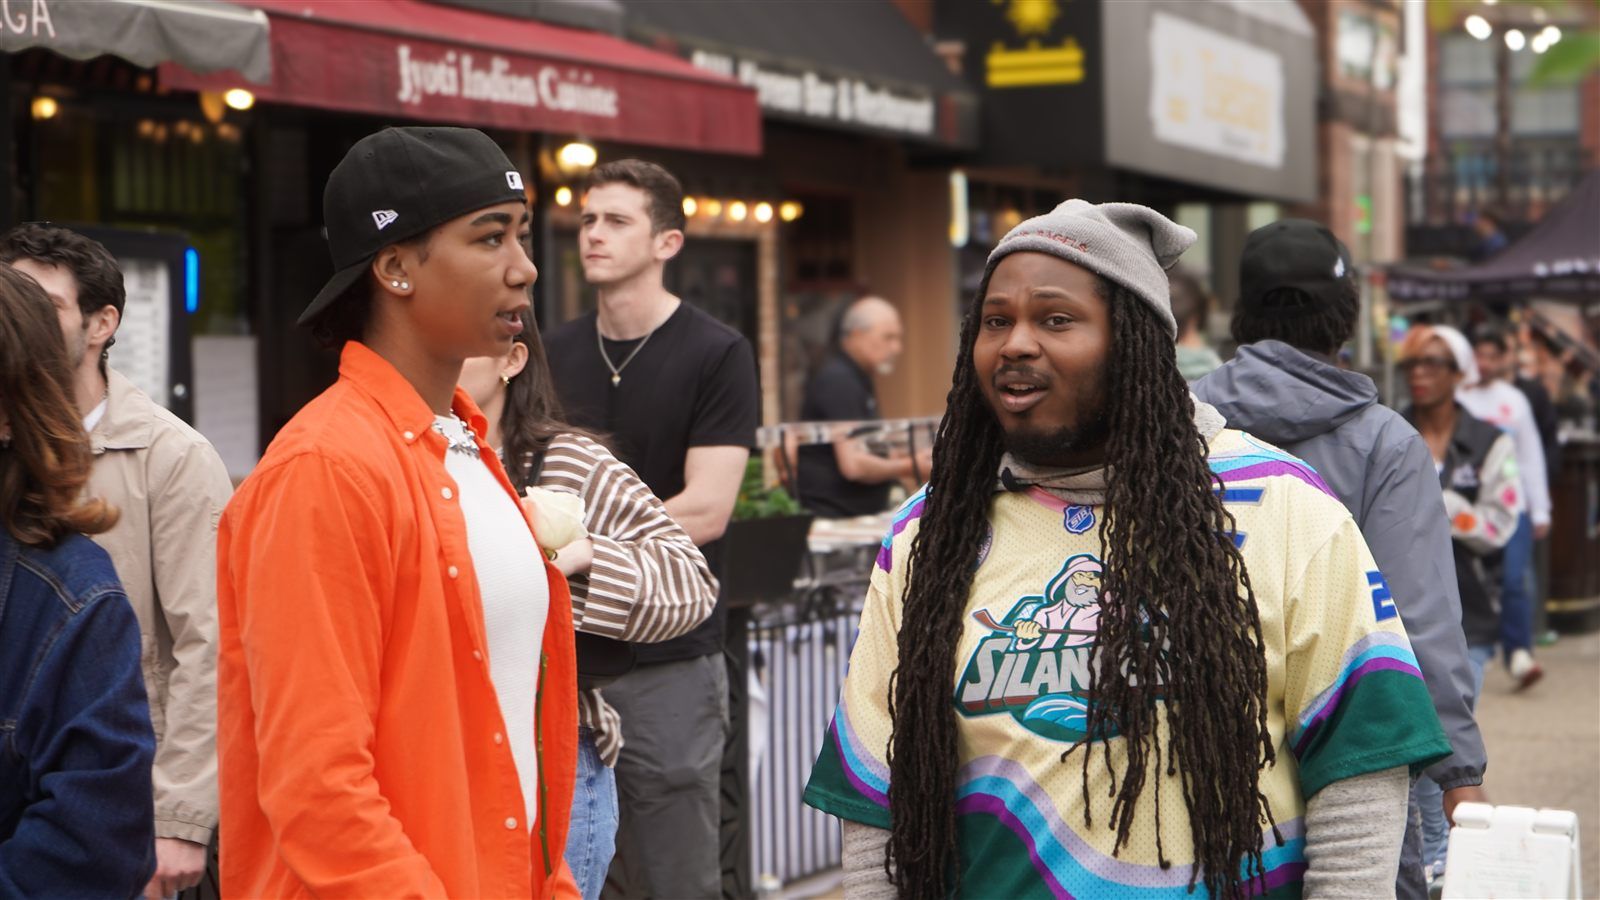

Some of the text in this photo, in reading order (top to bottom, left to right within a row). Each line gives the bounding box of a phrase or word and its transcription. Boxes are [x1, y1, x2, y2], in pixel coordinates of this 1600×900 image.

[398, 45, 618, 117] Jyoti Indian Cuisine
